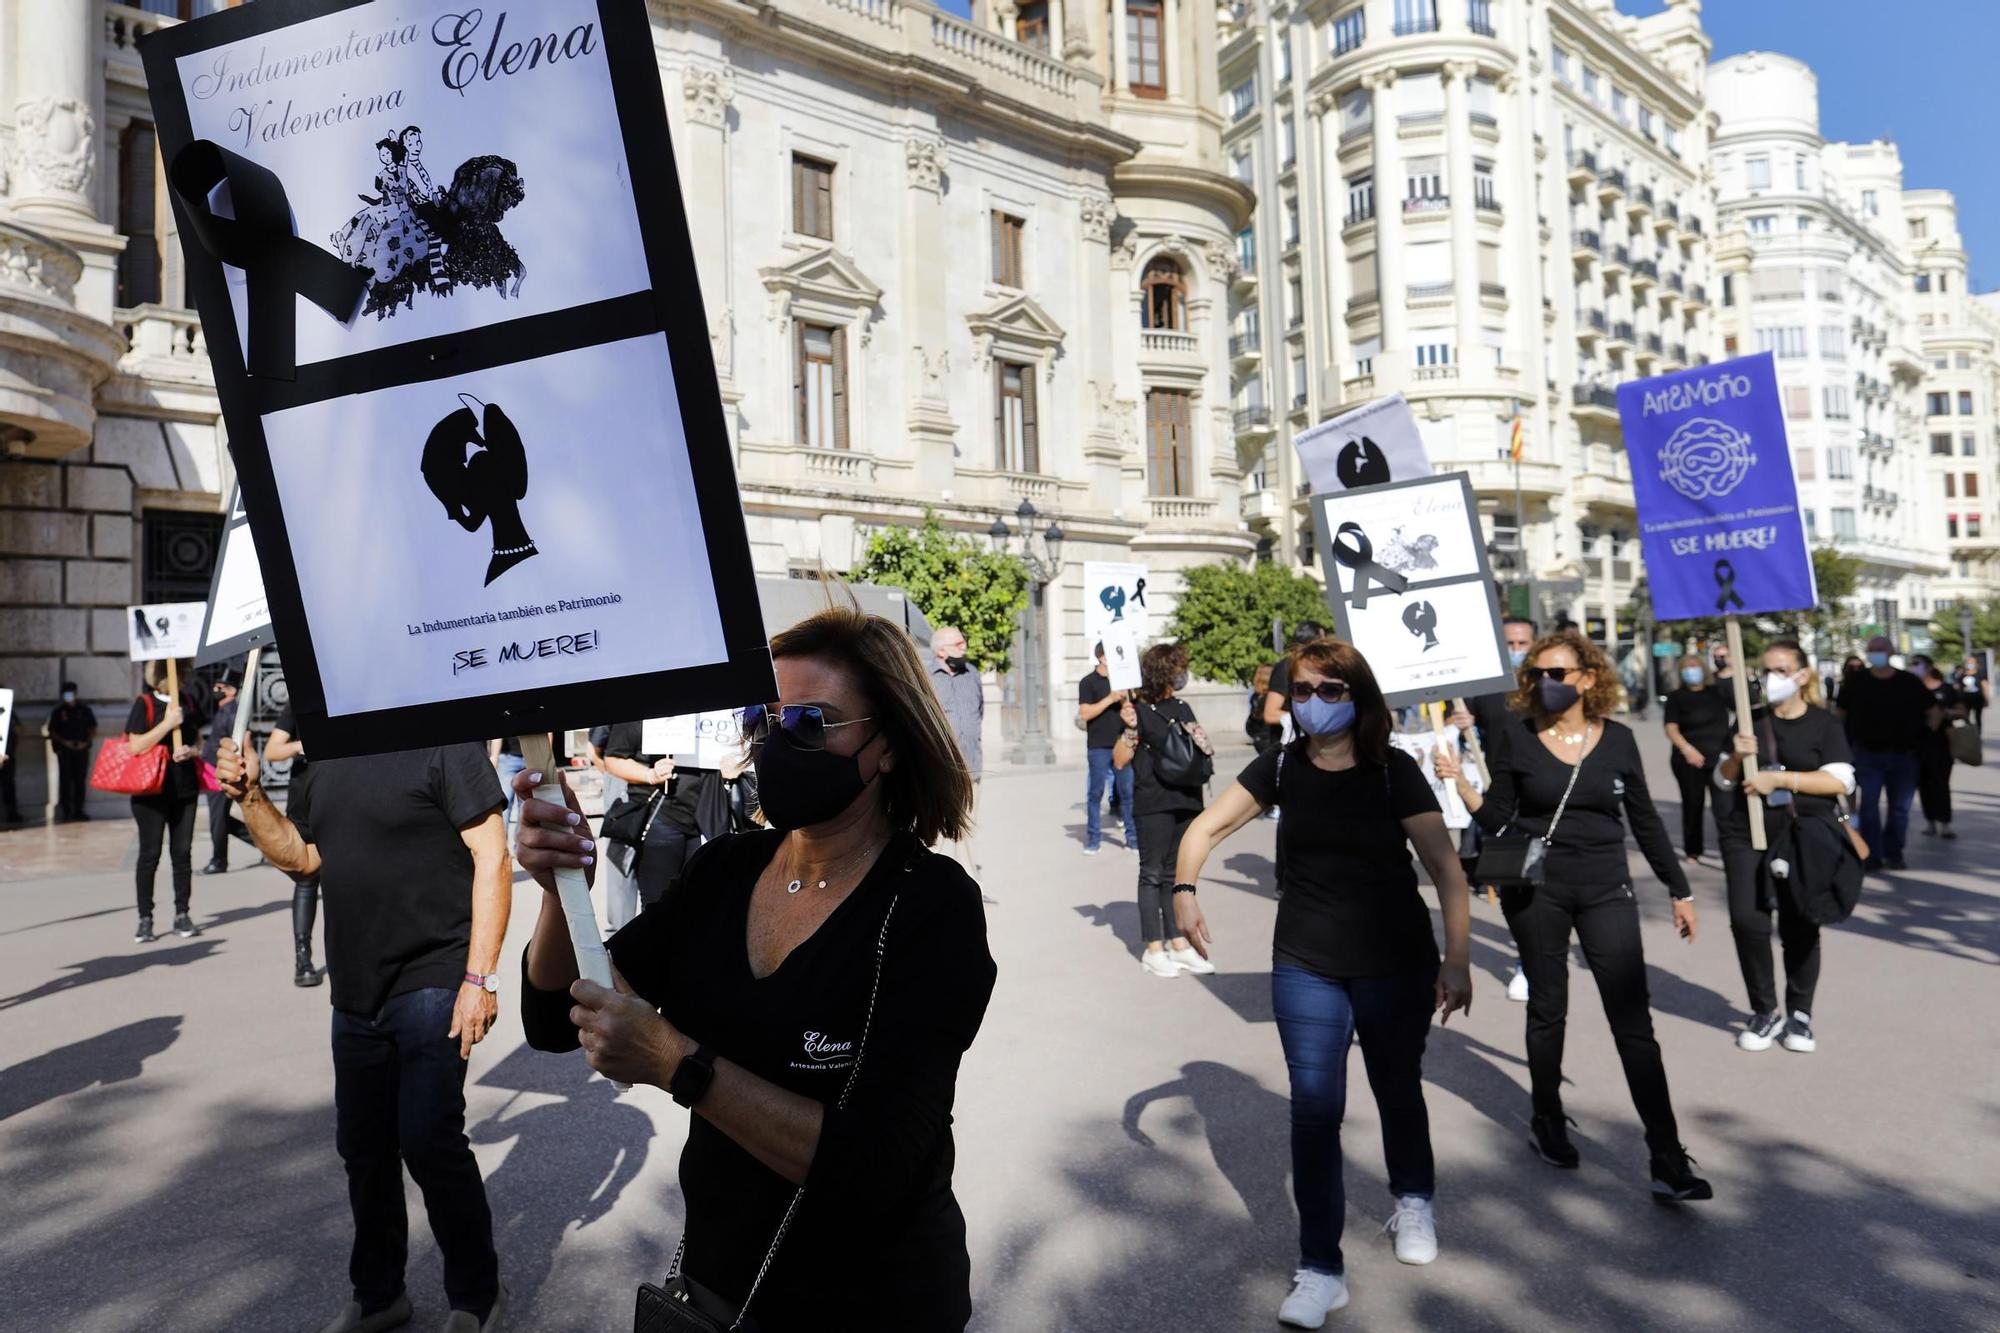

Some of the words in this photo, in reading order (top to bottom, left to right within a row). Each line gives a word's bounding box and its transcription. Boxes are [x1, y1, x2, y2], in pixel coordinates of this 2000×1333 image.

[192, 17, 420, 100] Indumentaria
[432, 8, 597, 97] Elena
[228, 88, 406, 148] Valenciana
[1704, 525, 1777, 551] MUERE!
[407, 624, 422, 635] La
[422, 611, 497, 633] Indumentaria
[497, 603, 543, 621] también
[545, 603, 558, 614] es
[558, 592, 622, 612] Patrimonio
[453, 648, 488, 676] ¡SE
[499, 629, 599, 663] MUERE!
[790, 1061, 827, 1070] Artesania
[803, 1031, 853, 1060] Elena
